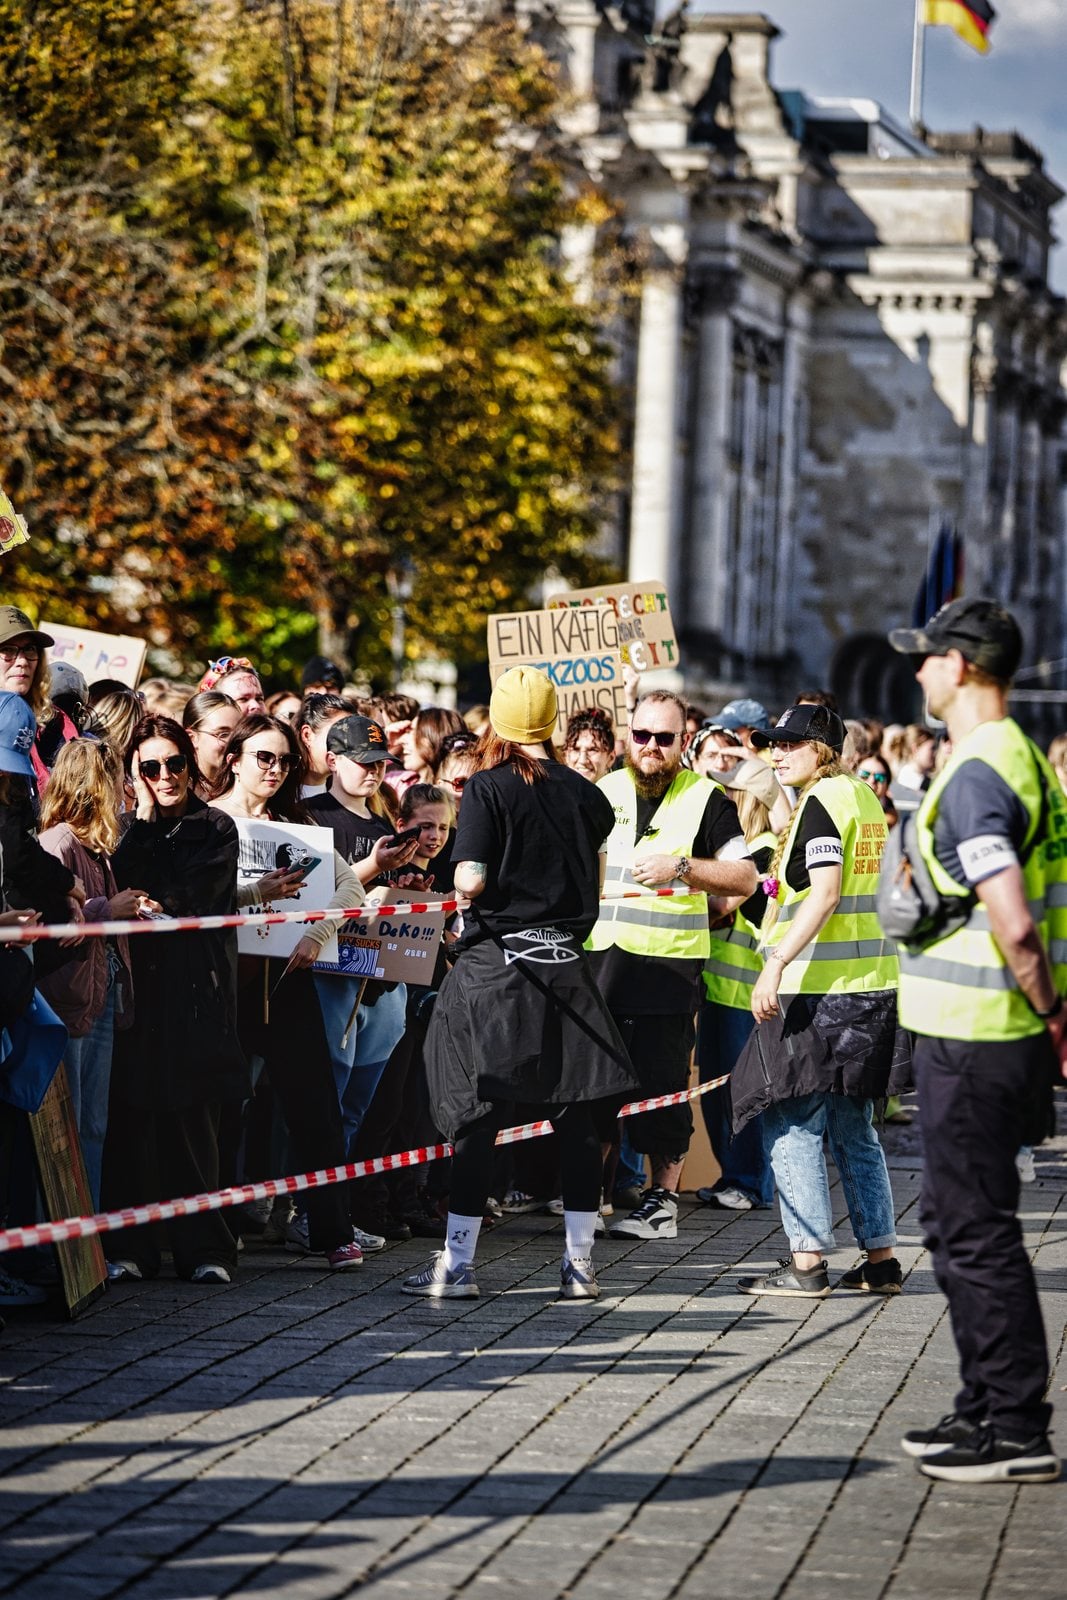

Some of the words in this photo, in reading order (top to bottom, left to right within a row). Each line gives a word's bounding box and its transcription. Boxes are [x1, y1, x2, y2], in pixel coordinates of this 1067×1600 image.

[549, 593, 667, 618] RECHT
[496, 615, 542, 657] EIN
[551, 609, 619, 655] KÄFIG
[530, 656, 615, 687] KZOOS
[556, 685, 628, 732] HAUSE
